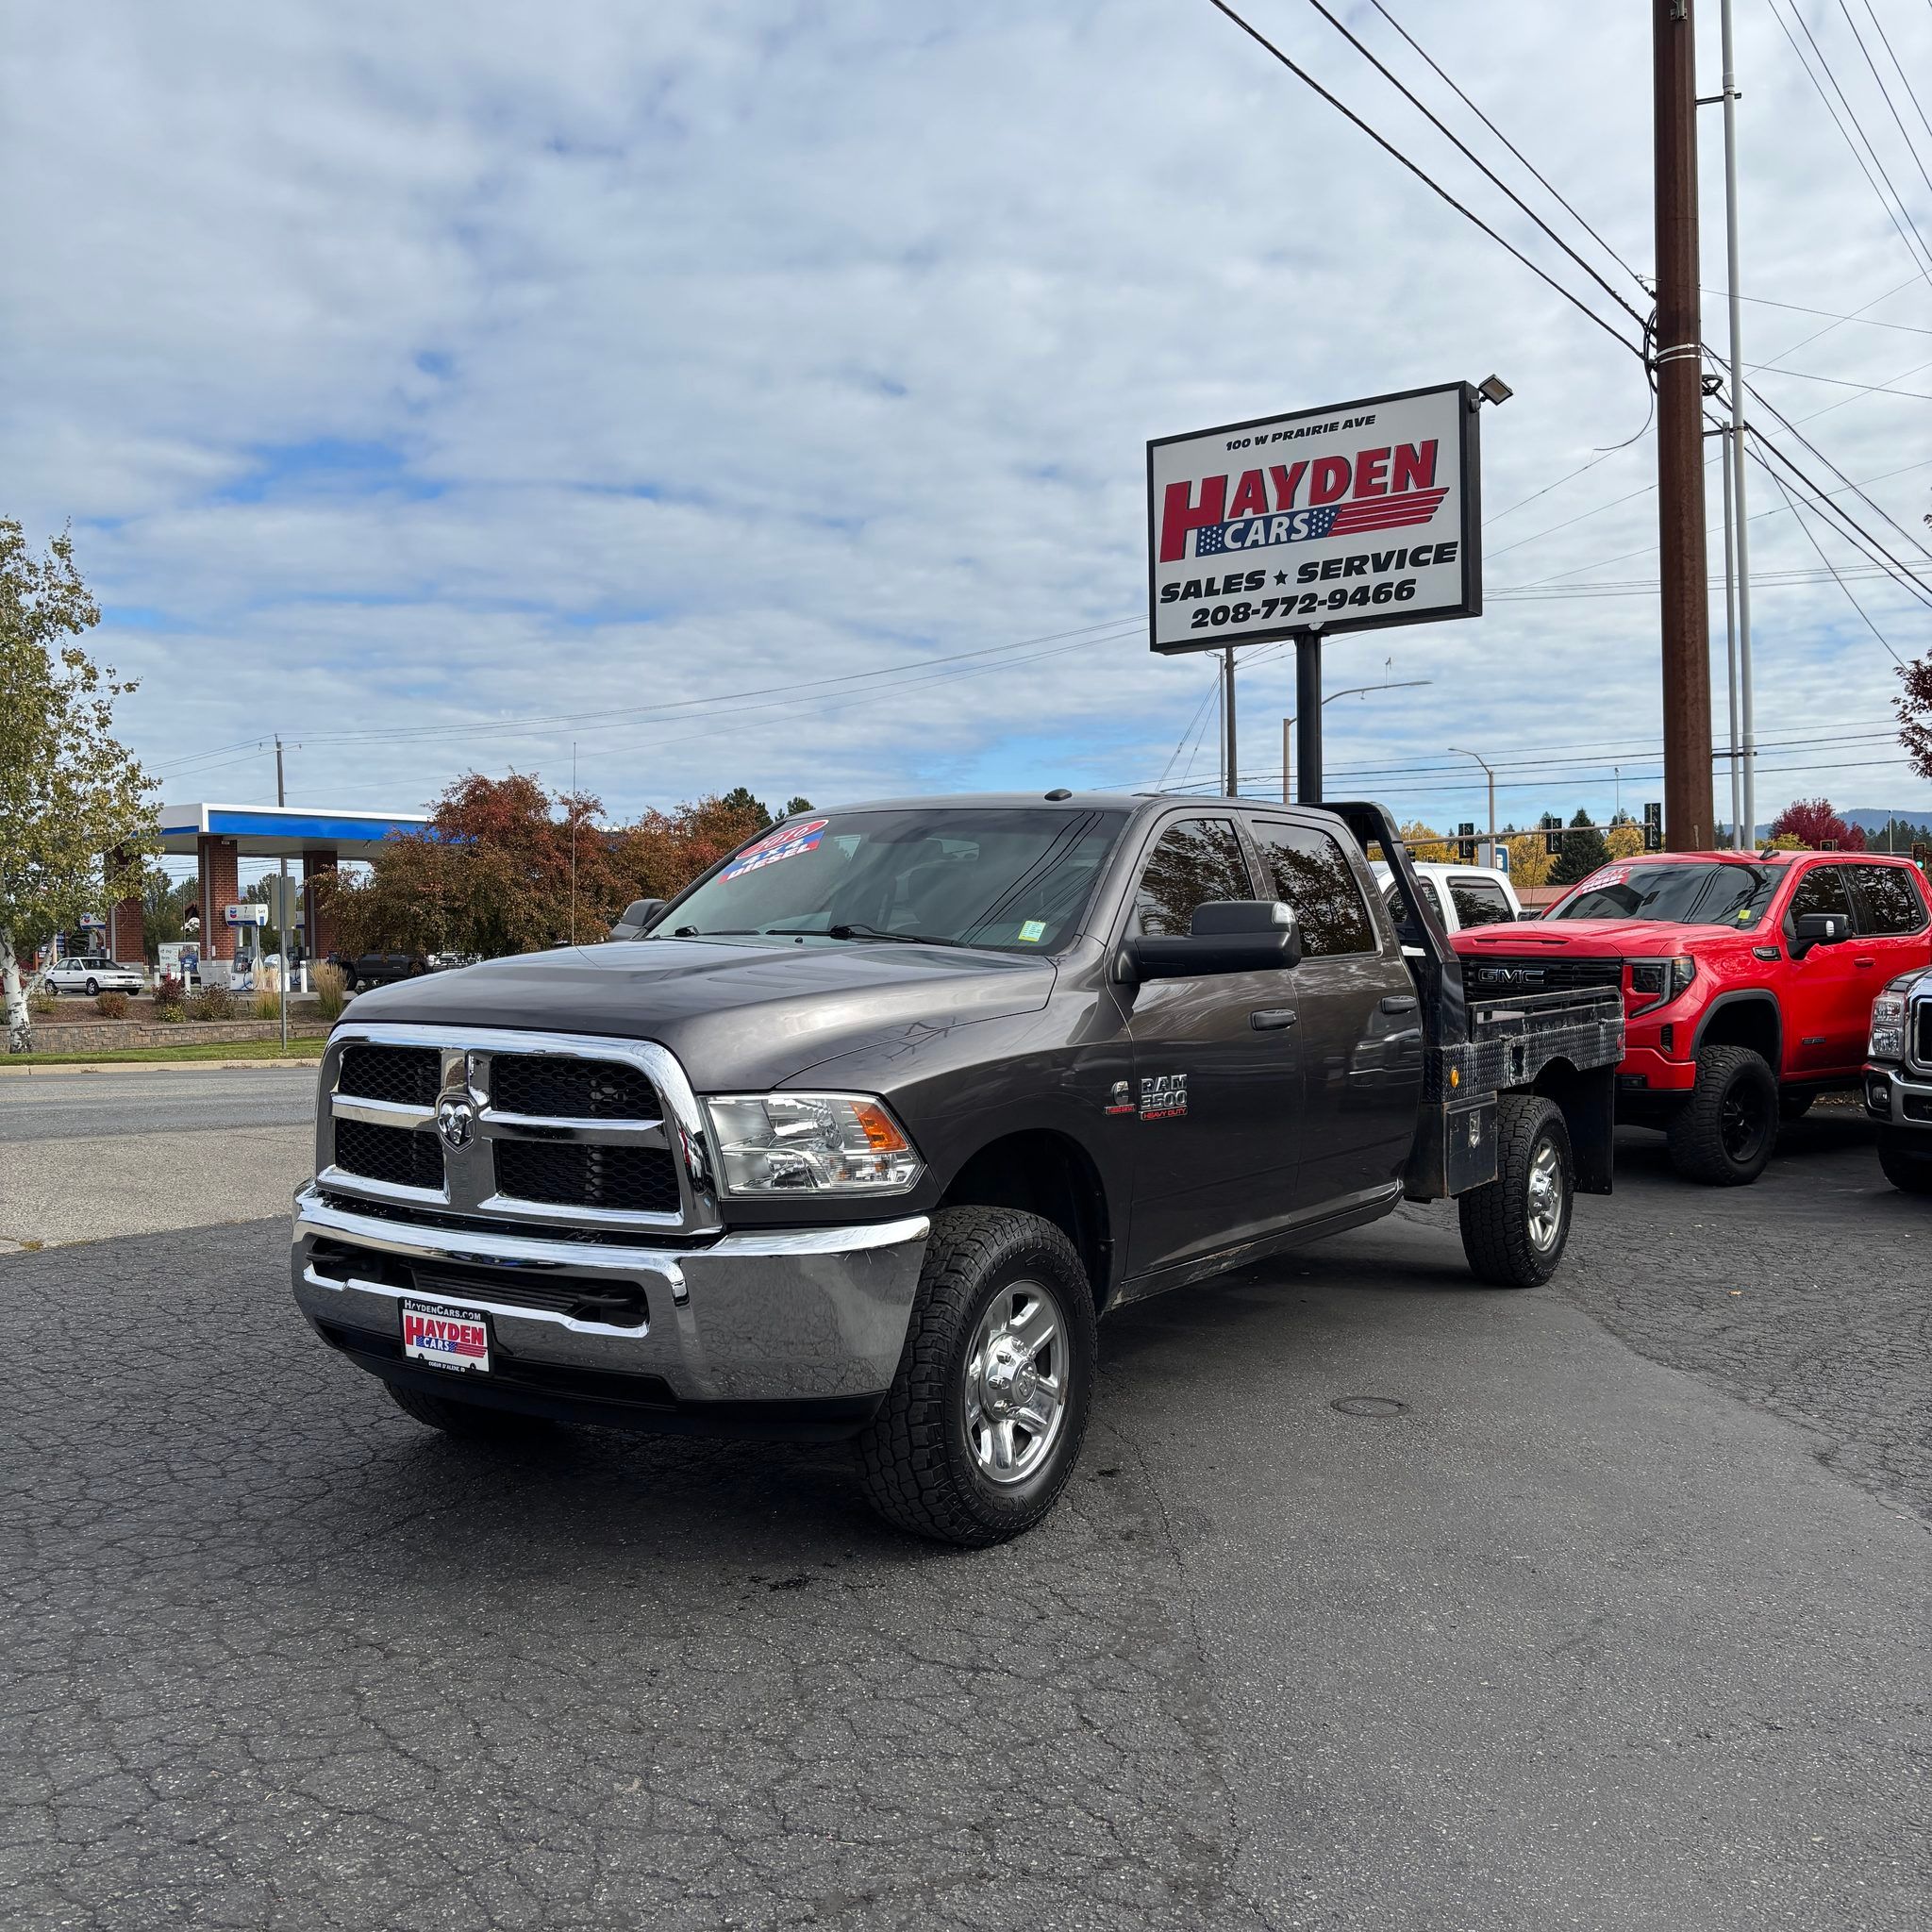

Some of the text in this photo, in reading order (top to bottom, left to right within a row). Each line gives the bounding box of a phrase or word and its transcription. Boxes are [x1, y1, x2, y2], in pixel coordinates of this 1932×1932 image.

[1225, 415, 1376, 451] 100 W PRAIRIE AVE
[1159, 440, 1439, 563] HAYDEN
[1224, 511, 1310, 550] CARS
[1159, 541, 1458, 604] SALES SERVICE
[1191, 579, 1416, 629] 208-772-9466
[727, 843, 810, 880] DIESEL
[1478, 968, 1545, 985] GMC
[1141, 1074, 1188, 1094] RAM
[1141, 1090, 1188, 1110] 3500
[406, 1314, 485, 1346] HAYDEN
[423, 1337, 450, 1351] CARS
